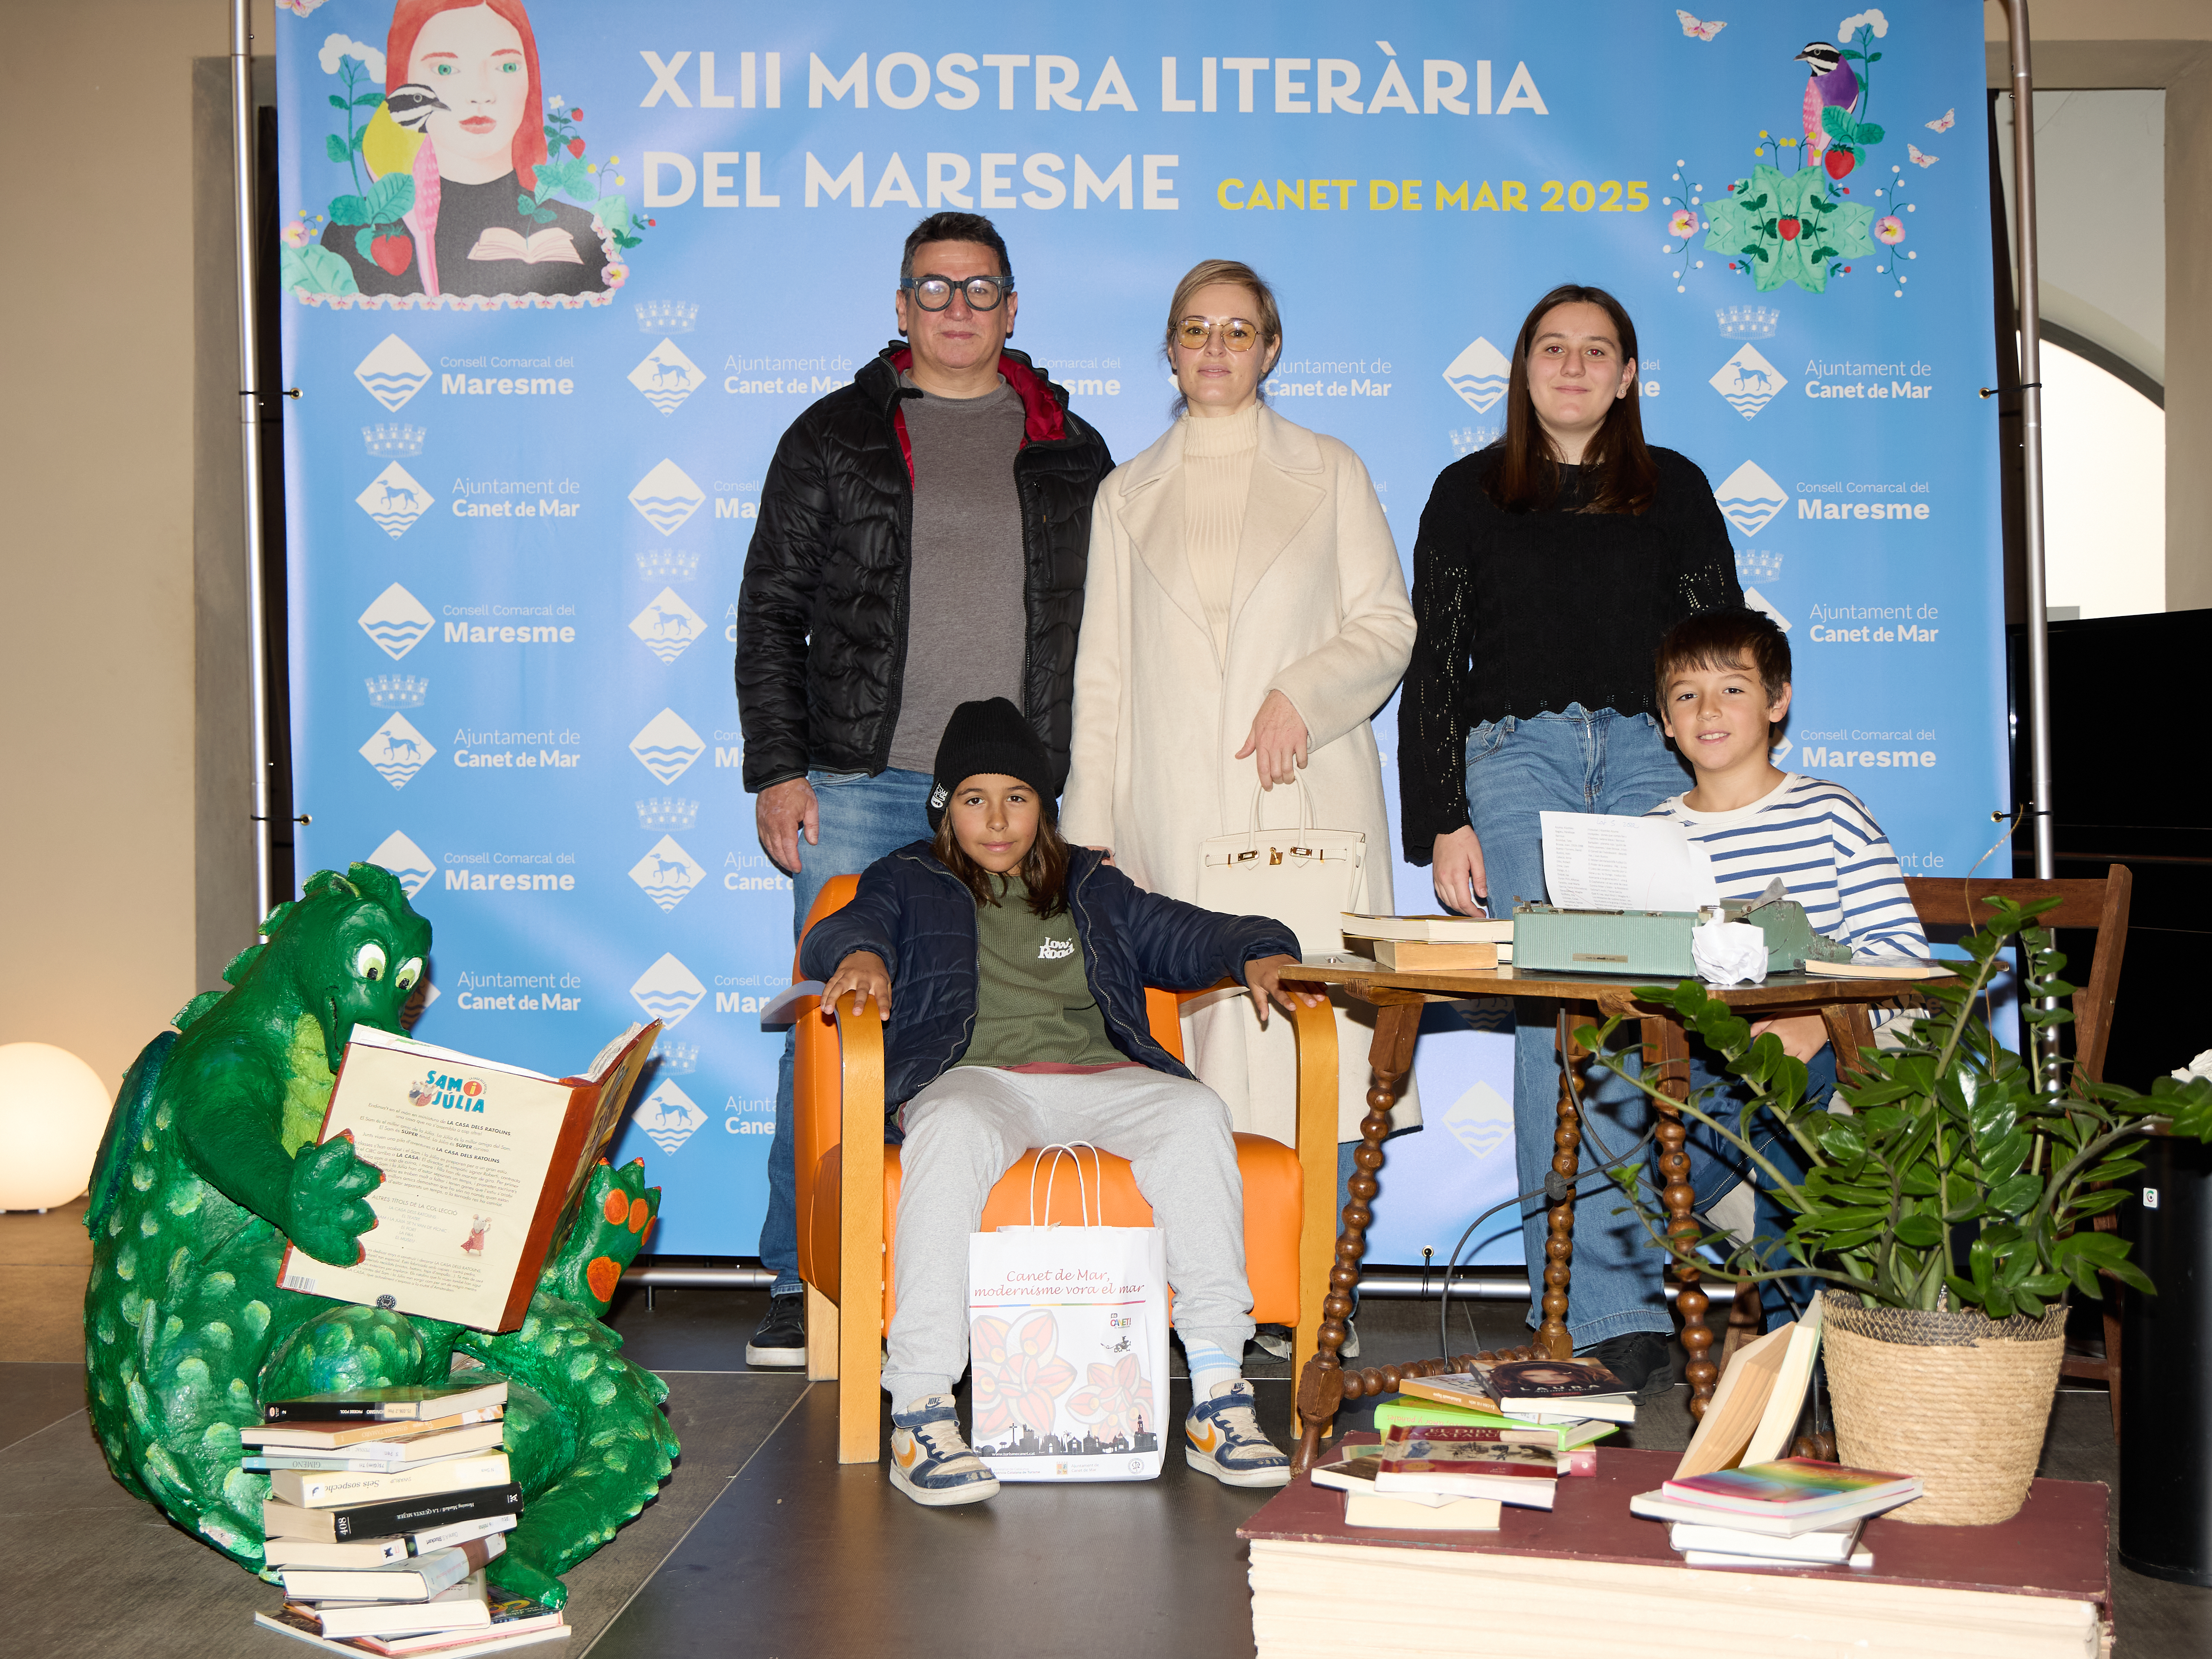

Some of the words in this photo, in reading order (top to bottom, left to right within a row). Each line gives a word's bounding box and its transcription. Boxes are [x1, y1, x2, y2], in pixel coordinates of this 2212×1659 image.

[640, 51, 780, 108] XLII
[809, 52, 1138, 111] MOSTRA
[1162, 41, 1549, 115] LITERÀRIA
[642, 151, 780, 207] DEL
[805, 152, 1179, 210] MARESME
[1217, 179, 1350, 211] CANET
[1370, 180, 1422, 210] DE
[1436, 180, 1527, 211] MAR
[1541, 180, 1649, 212] 2025
[441, 356, 486, 367] Consell
[491, 356, 551, 367] Comarcal
[555, 356, 574, 367] del
[724, 355, 826, 374] Ajuntament
[831, 355, 852, 370] de
[1039, 358, 1098, 368] Comarcal
[1102, 357, 1121, 368] del
[1274, 358, 1366, 377] juntament
[1371, 358, 1391, 373] de
[1641, 359, 1660, 370] del
[1805, 360, 1906, 379] Ajuntament
[1910, 361, 1931, 376] de
[442, 374, 573, 394] Maresme
[724, 376, 783, 393] Canet
[787, 379, 807, 393] de
[1265, 379, 1323, 396] Canet
[1327, 382, 1347, 396] de
[1352, 379, 1391, 396] Mar
[1805, 381, 1864, 398] Canet
[1867, 383, 1888, 398] de
[1892, 382, 1932, 398] Mar
[452, 478, 552, 497] Ajuntament
[559, 478, 580, 494] de
[714, 481, 759, 491] Consell
[1796, 482, 1843, 492] Consell
[1847, 482, 1907, 493] Comarcal
[1910, 482, 1929, 493] del
[452, 499, 512, 517] Canet
[515, 502, 536, 517] de
[540, 499, 580, 516] Mar
[1798, 499, 1929, 519] Maresme
[443, 604, 488, 616] Consell
[493, 604, 553, 616] Comarcal
[556, 604, 575, 615] del
[1810, 604, 1912, 623] Ajuntament
[1917, 603, 1938, 619] de
[445, 622, 575, 643] Maresme
[1810, 625, 1870, 642] Canet
[1873, 627, 1894, 642] de
[1898, 625, 1939, 642] Mar
[454, 729, 555, 748] Ajuntament
[559, 728, 580, 744] de
[1801, 730, 1848, 740] Consell
[1852, 730, 1913, 740] Comarcal
[1917, 730, 1936, 740] del
[454, 750, 513, 767] Canet
[516, 752, 536, 767] de
[540, 750, 580, 767] Mar
[1803, 747, 1936, 767] Maresme
[444, 852, 490, 863] Consell
[494, 852, 553, 863] Comarcal
[556, 852, 575, 863] del
[1923, 851, 1943, 868] de
[446, 870, 575, 890] Maresme
[724, 873, 782, 890] Canet
[1038, 943, 1075, 959] Road
[1044, 937, 1069, 948] Low
[458, 972, 555, 990] Ajuntament
[560, 972, 581, 988] de
[715, 975, 760, 986] Consell
[458, 992, 515, 1010] Canet
[519, 995, 538, 1010] de
[542, 993, 581, 1010] Mar
[425, 1070, 463, 1092] SAM
[432, 1091, 485, 1113] JÚLIA
[401, 1129, 418, 1137] SÚPER
[725, 1117, 776, 1135] Cane
[372, 1195, 391, 1203] ALTRES
[392, 1197, 408, 1206] TÍTOLS
[1007, 1270, 1053, 1281] Canet
[1055, 1269, 1075, 1280] de
[1077, 1269, 1110, 1282] Mar,
[975, 1285, 1064, 1296] modernisme
[1066, 1286, 1099, 1294] vora
[1102, 1283, 1116, 1294] el
[1119, 1284, 1145, 1294] mar
[1110, 1318, 1131, 1326] CANET!
[1387, 1415, 1415, 1424] pañales
[362, 1429, 384, 1437] TAMARO
[384, 1425, 408, 1434] SUSANNA
[363, 1480, 380, 1488] Seis
[413, 1509, 432, 1517] QUINTA
[458, 1502, 474, 1510] Henning
[338, 1517, 348, 1535] 408
